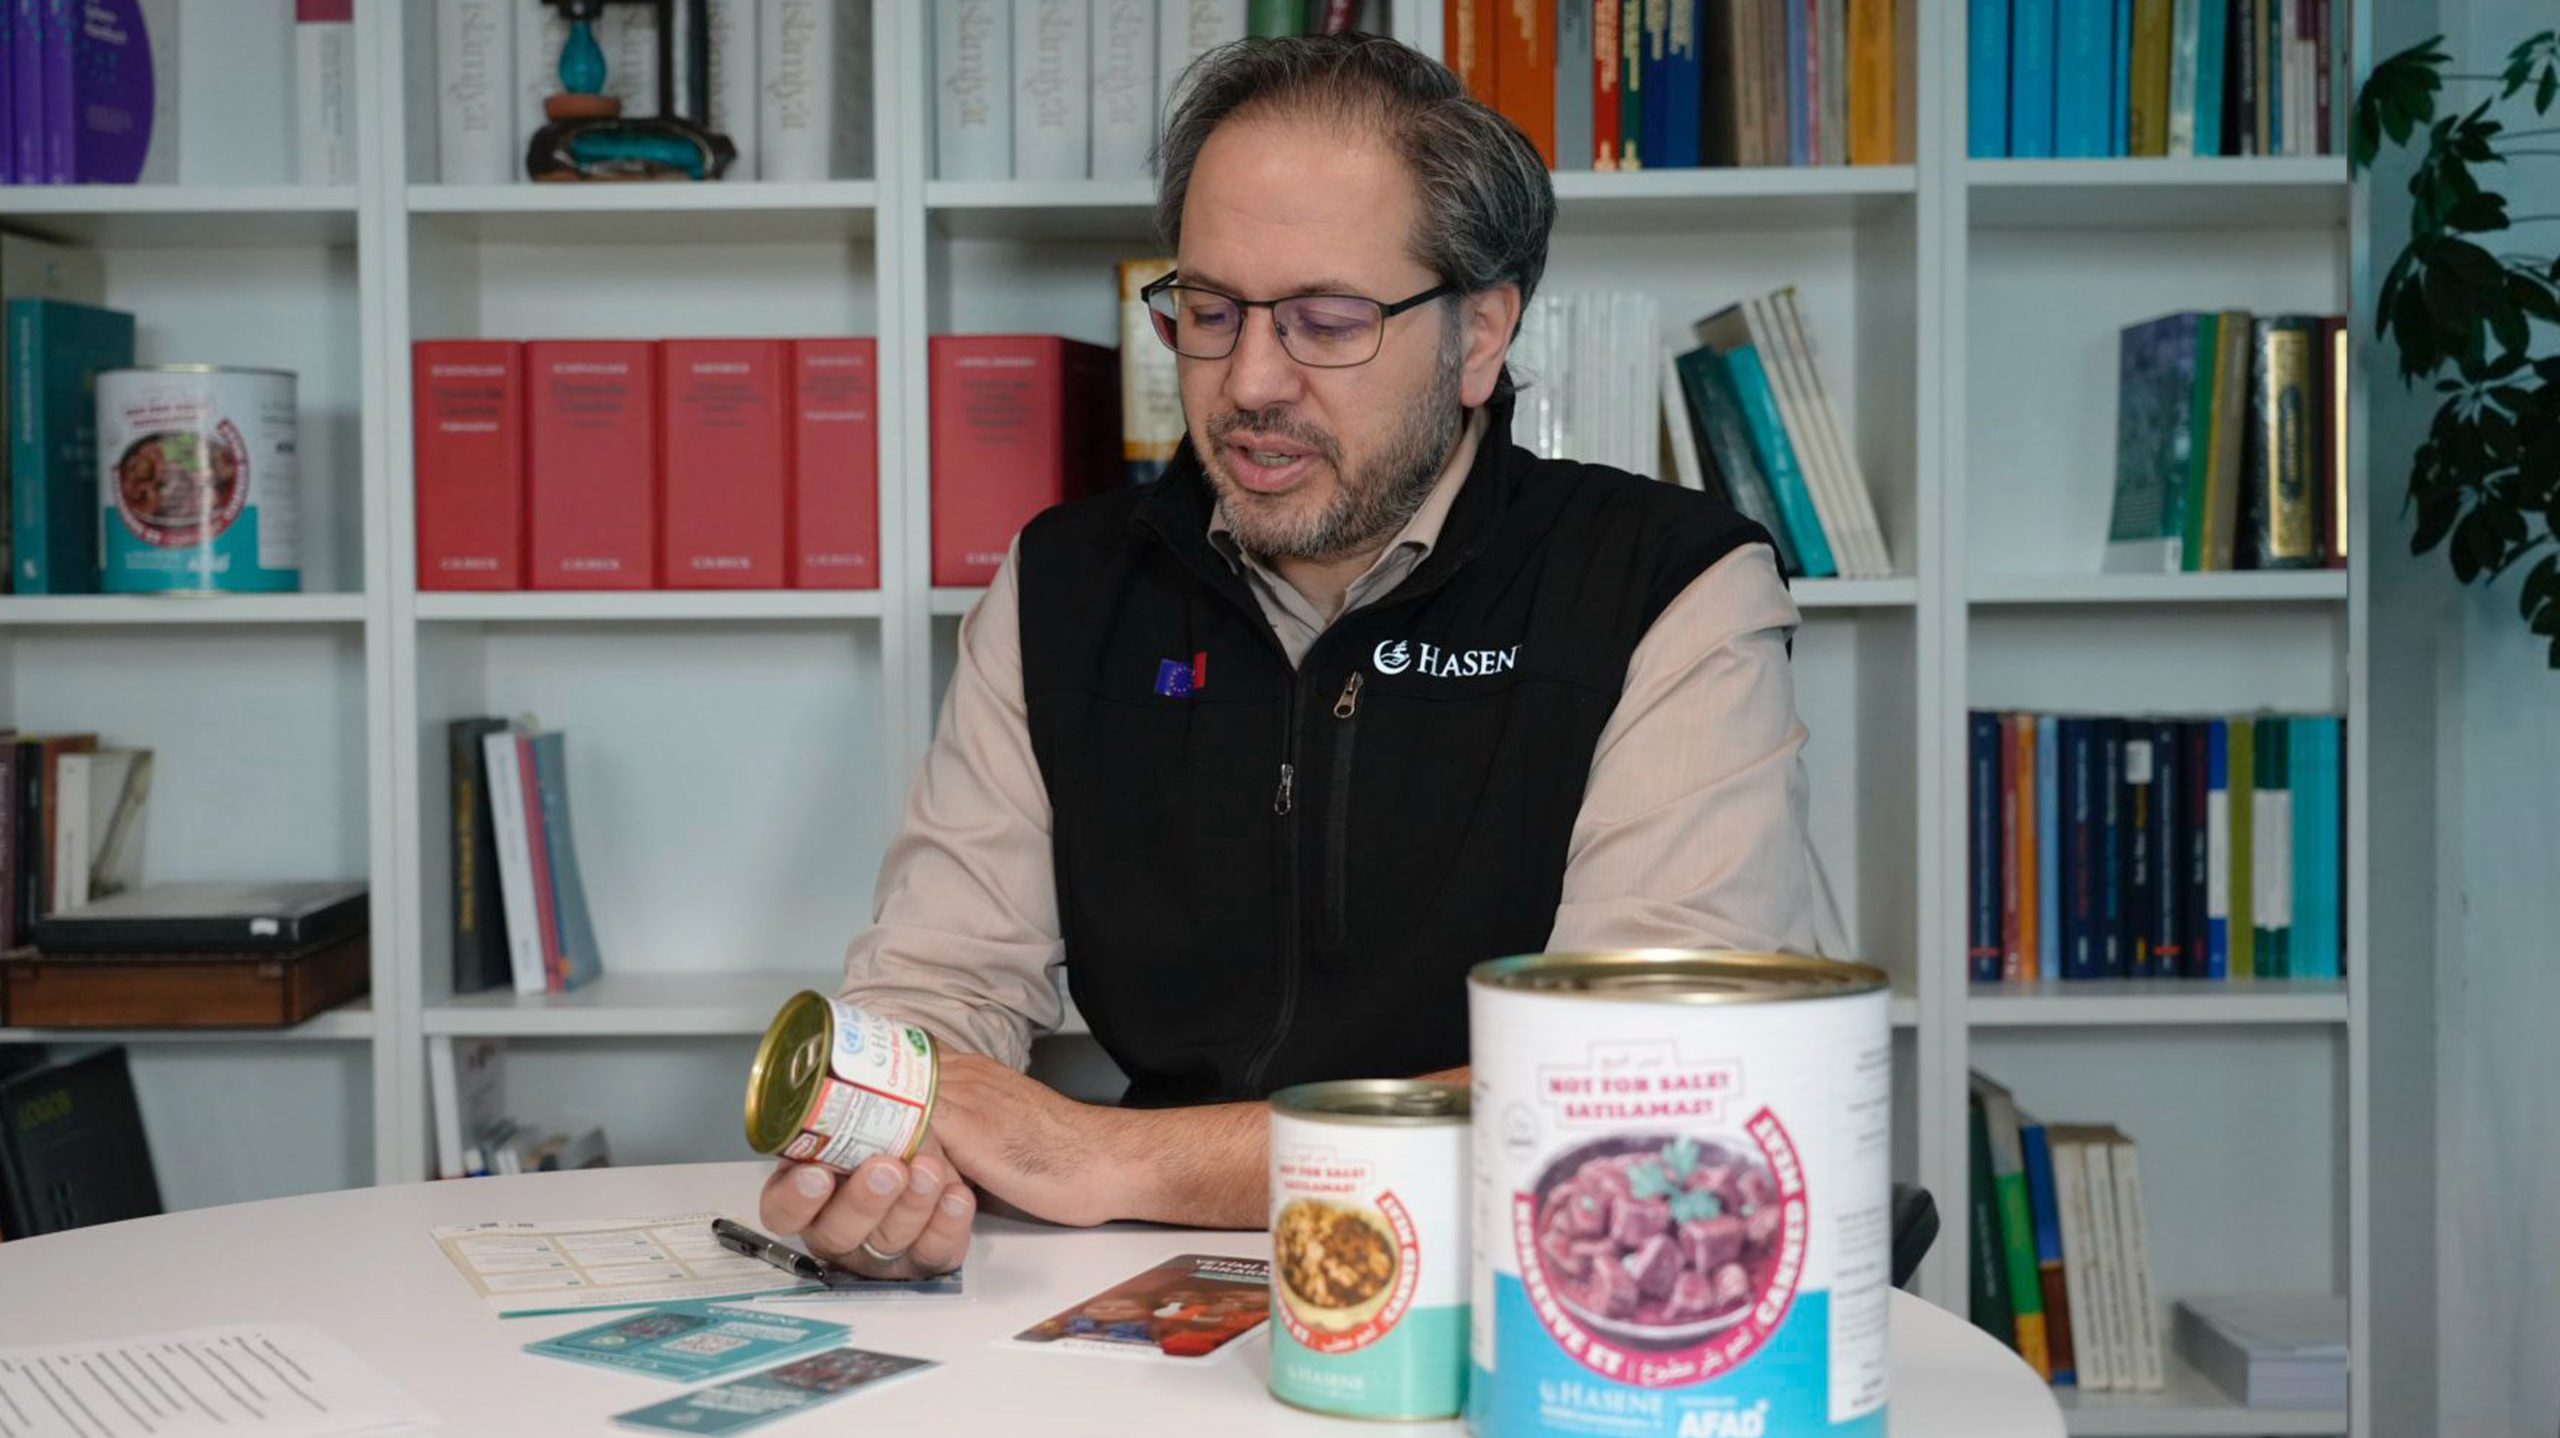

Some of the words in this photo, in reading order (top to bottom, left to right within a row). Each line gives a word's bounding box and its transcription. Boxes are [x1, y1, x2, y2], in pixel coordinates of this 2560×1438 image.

[1417, 643, 1519, 677] HASEN
[1549, 1078, 1592, 1094] NOT
[1602, 1077, 1649, 1093] FOR
[1754, 1117, 1802, 1196] MEAT
[1755, 1199, 1805, 1326] CANNED
[1586, 1343, 1625, 1374] ET
